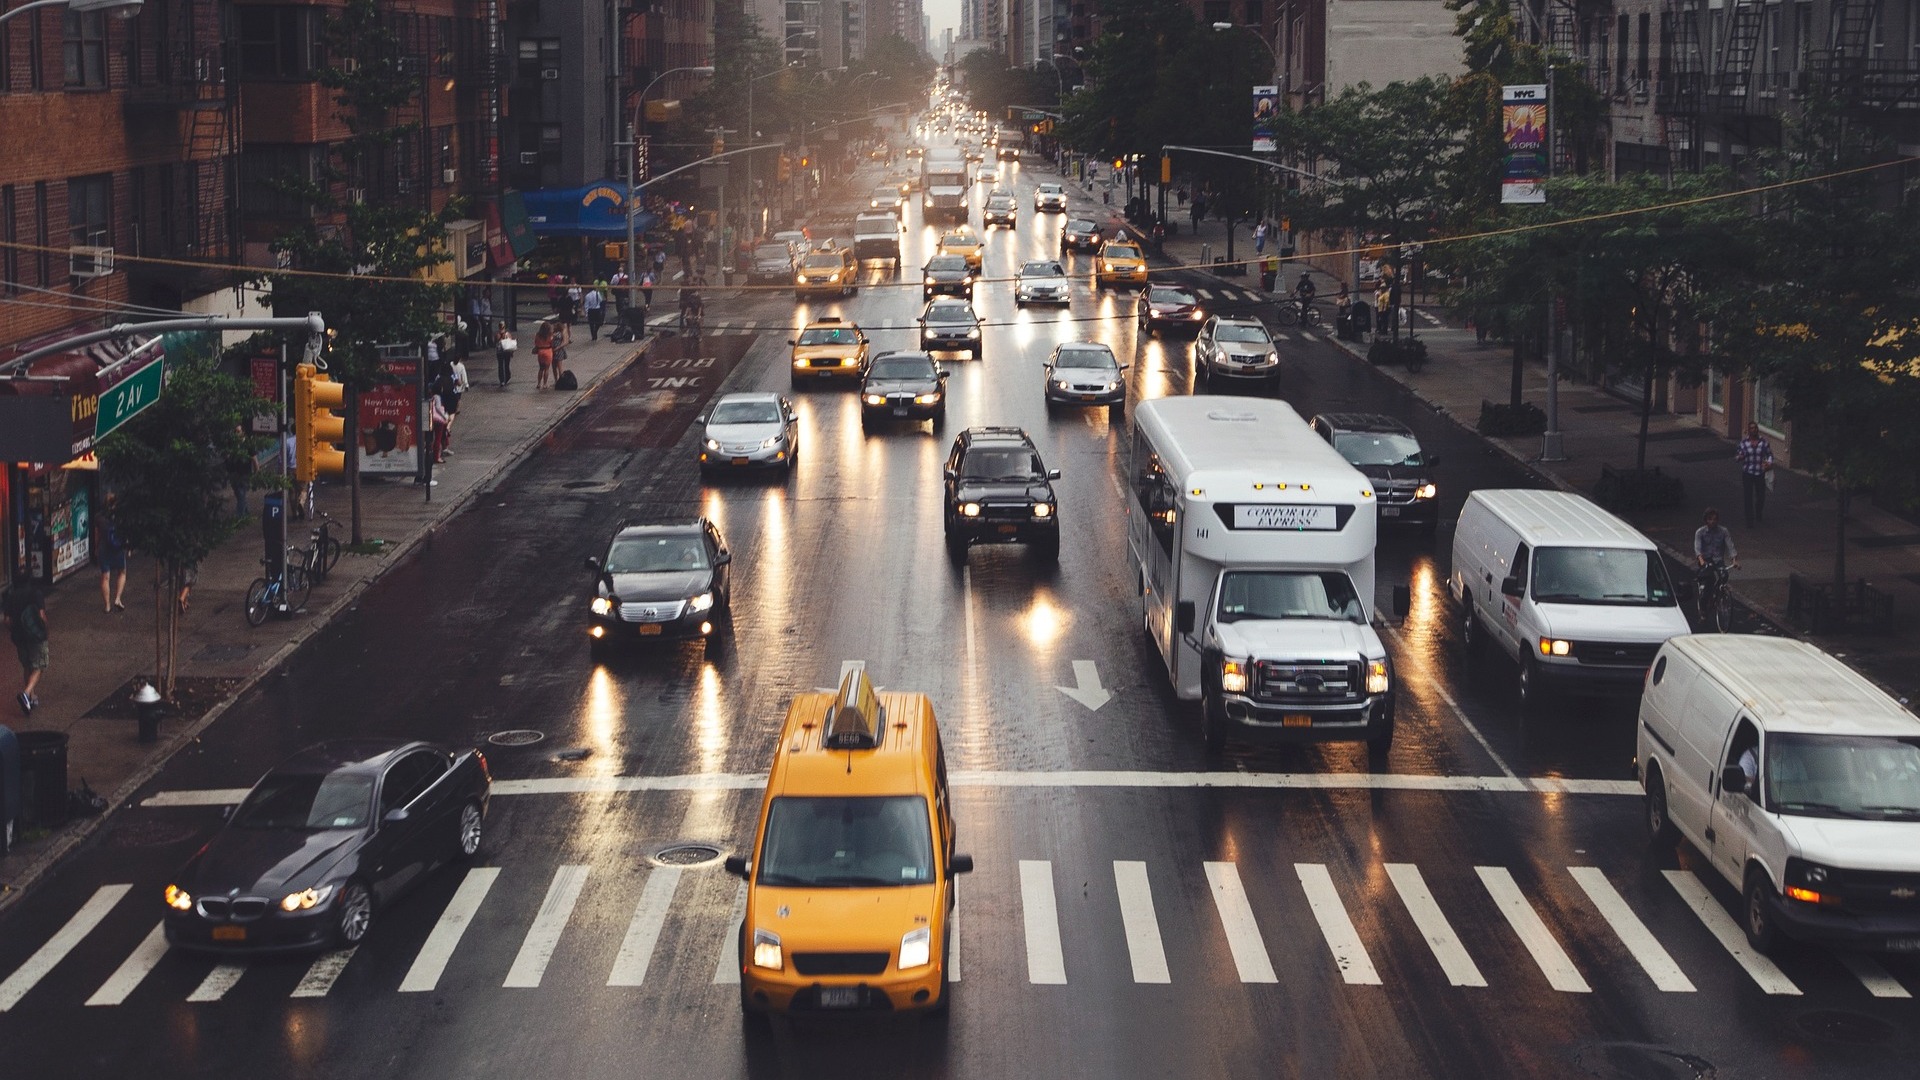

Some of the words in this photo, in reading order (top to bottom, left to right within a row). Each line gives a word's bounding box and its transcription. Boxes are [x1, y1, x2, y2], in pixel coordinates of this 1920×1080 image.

[1508, 141, 1518, 149] US
[1519, 141, 1540, 149] OPEN
[115, 390, 125, 418] 2
[126, 383, 143, 411] Av
[364, 399, 383, 407] New
[385, 399, 410, 407] York's
[374, 408, 400, 416] Finest
[272, 506, 279, 518] P
[1247, 507, 1321, 517] CORPORATE
[1257, 517, 1312, 527] EXPRESS
[1196, 527, 1209, 539] 141
